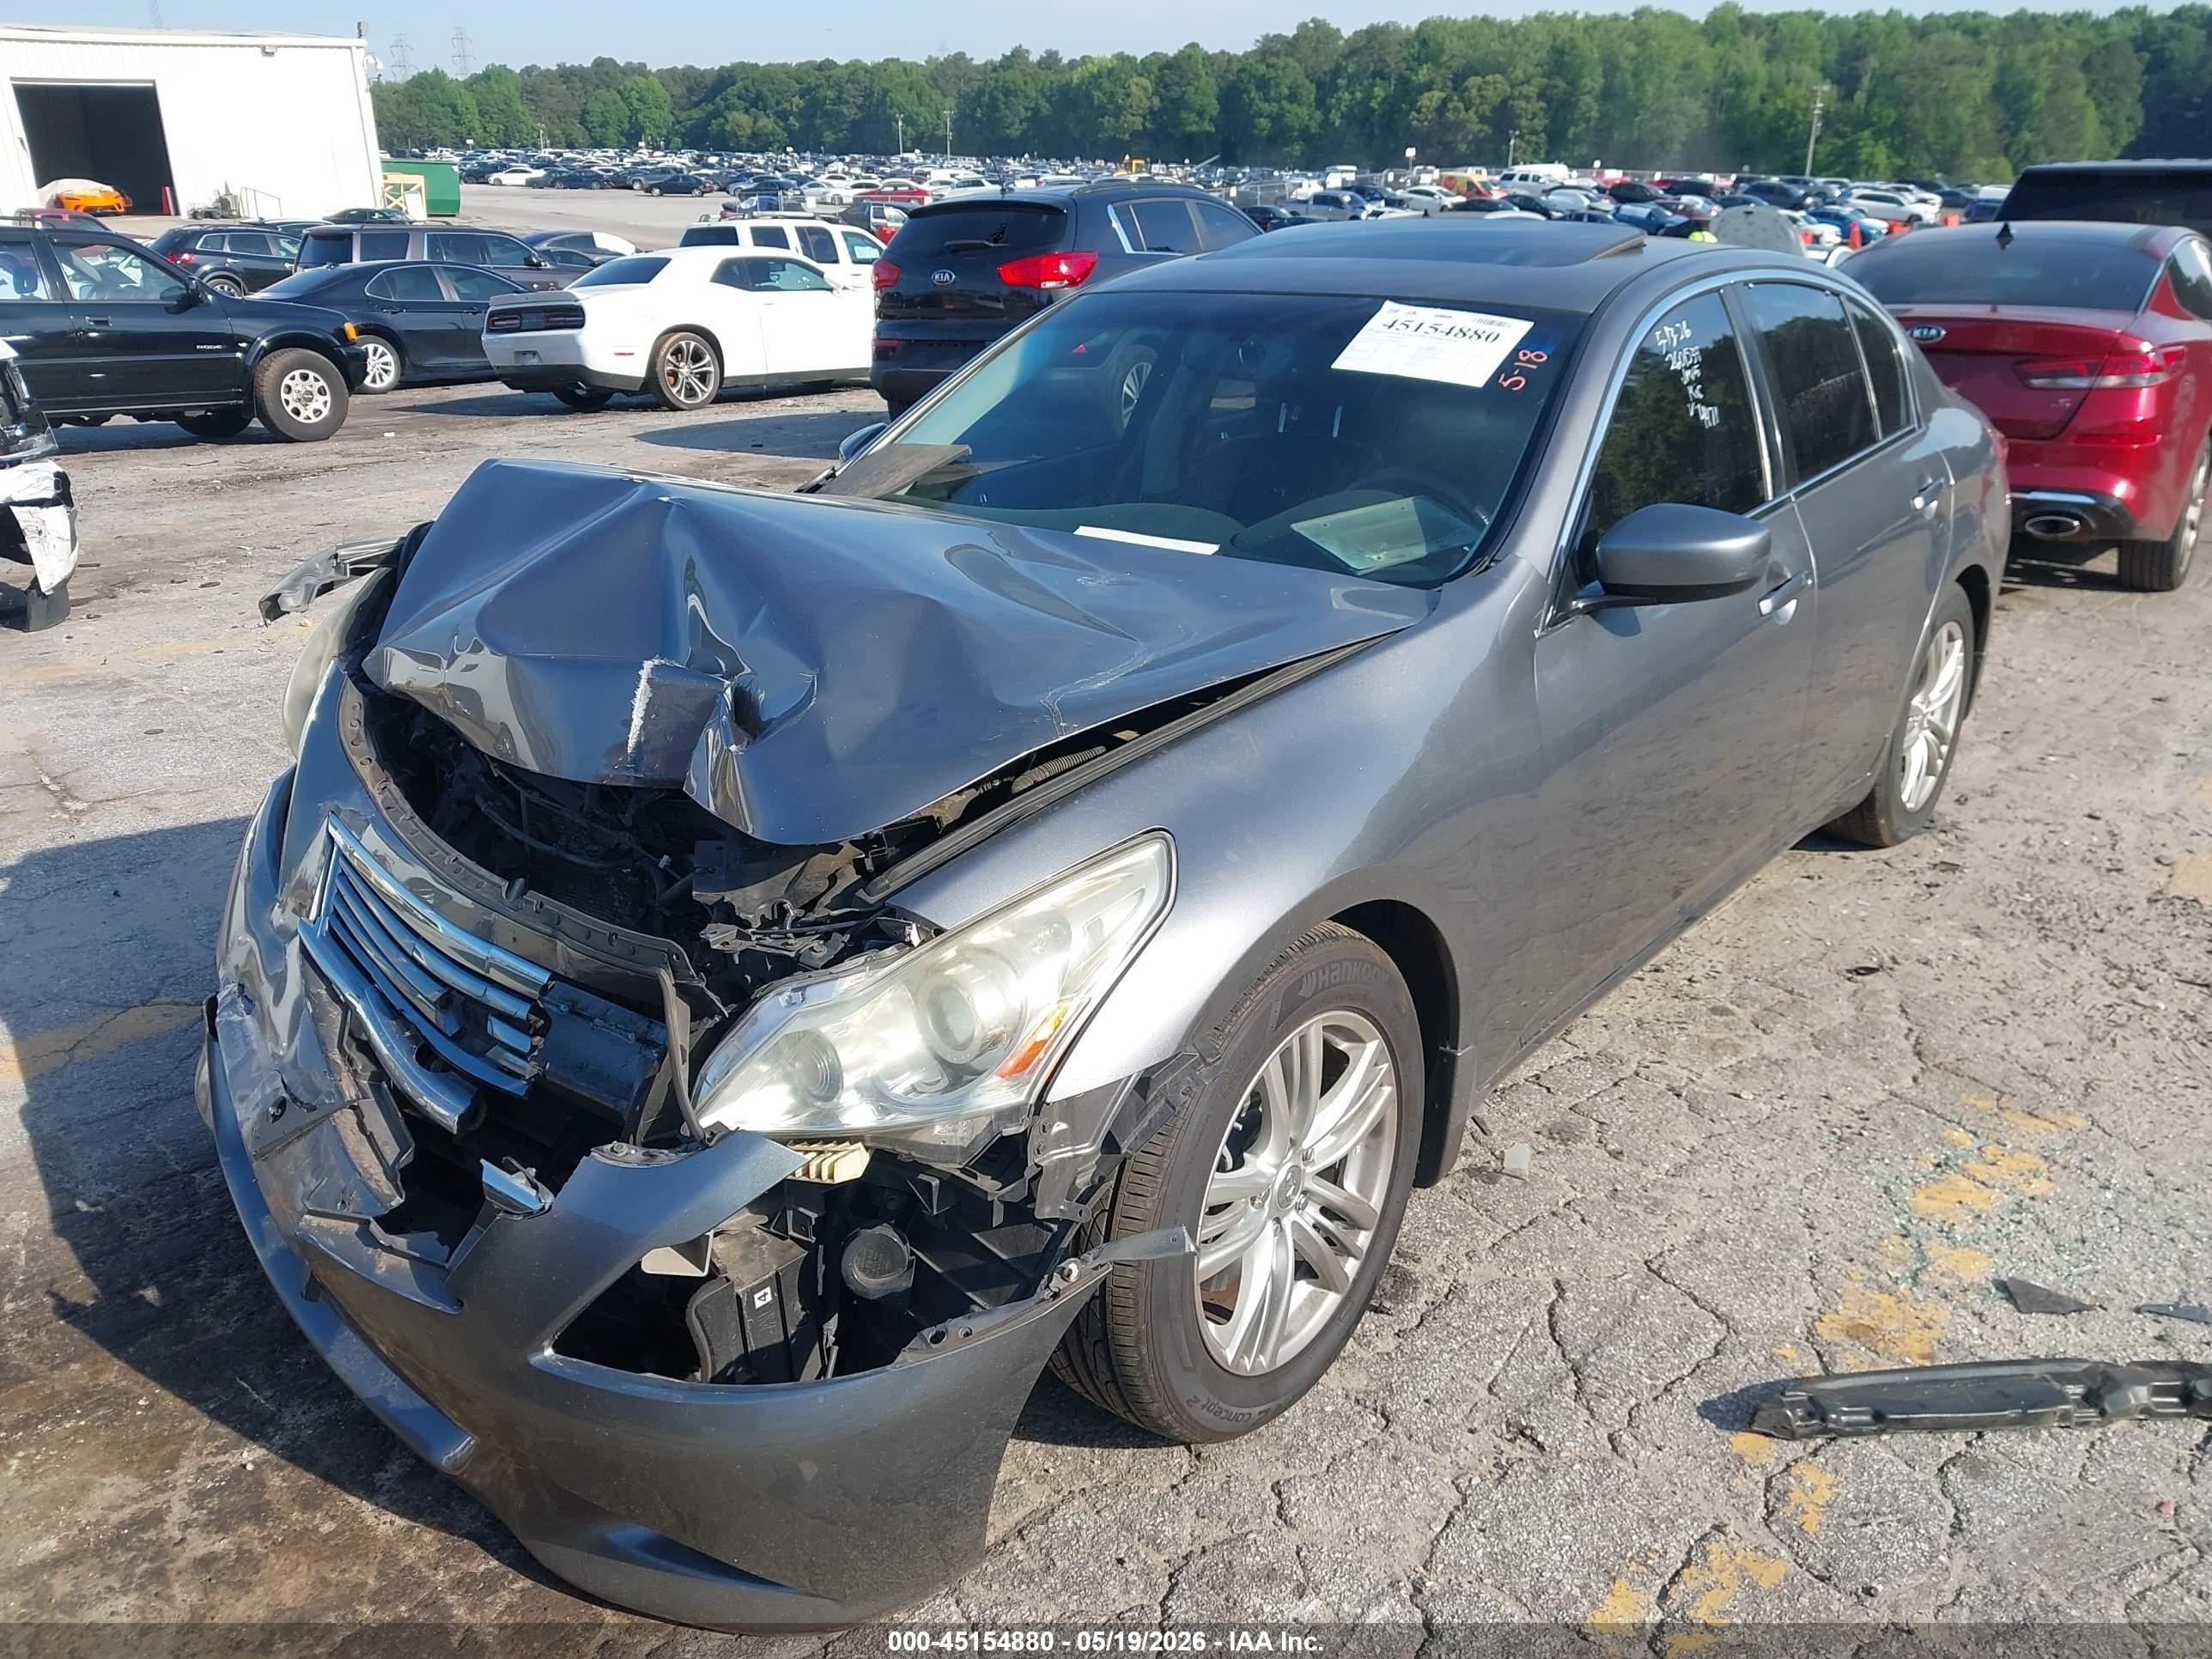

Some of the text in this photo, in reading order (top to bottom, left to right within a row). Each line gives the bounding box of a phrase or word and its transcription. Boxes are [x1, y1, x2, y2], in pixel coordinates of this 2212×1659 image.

[934, 272, 951, 283] KIA
[1382, 318, 1501, 343] 45154880
[1912, 327, 1938, 338] KIA
[1498, 349, 1547, 392] 5-18
[1201, 1395, 1252, 1424] concept
